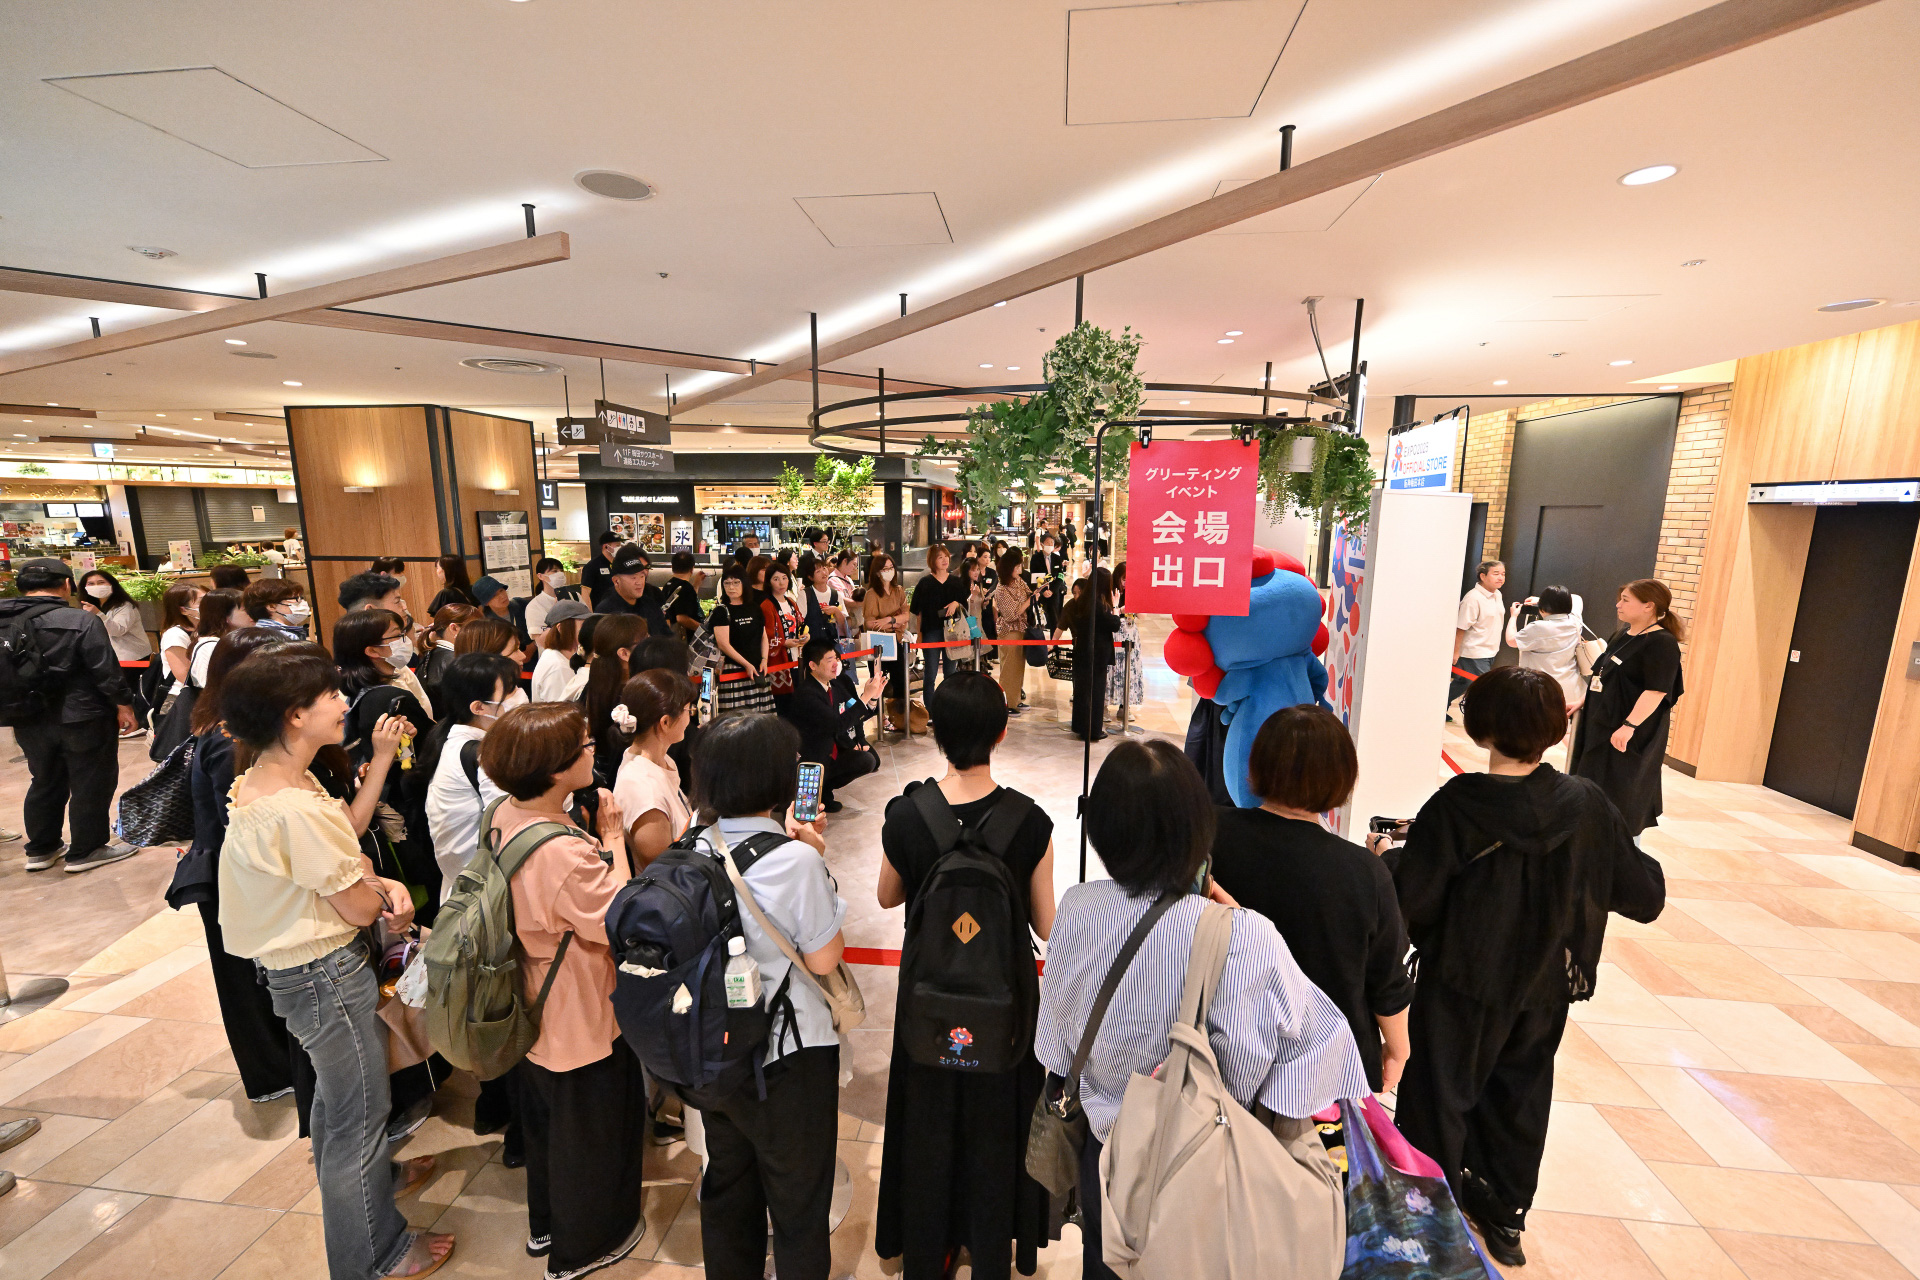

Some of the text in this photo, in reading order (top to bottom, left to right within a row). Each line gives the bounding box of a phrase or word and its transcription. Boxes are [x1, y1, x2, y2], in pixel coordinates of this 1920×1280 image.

[1403, 441, 1429, 458] EXPO2025
[1402, 456, 1448, 475] OFFICIAL STORE
[1145, 466, 1242, 482] グリーティング
[1165, 485, 1218, 499] イベント
[1151, 510, 1230, 545] 会場
[675, 530, 691, 545] 氷
[1151, 554, 1226, 588] 出口
[938, 1056, 979, 1067] ミャクミャク
